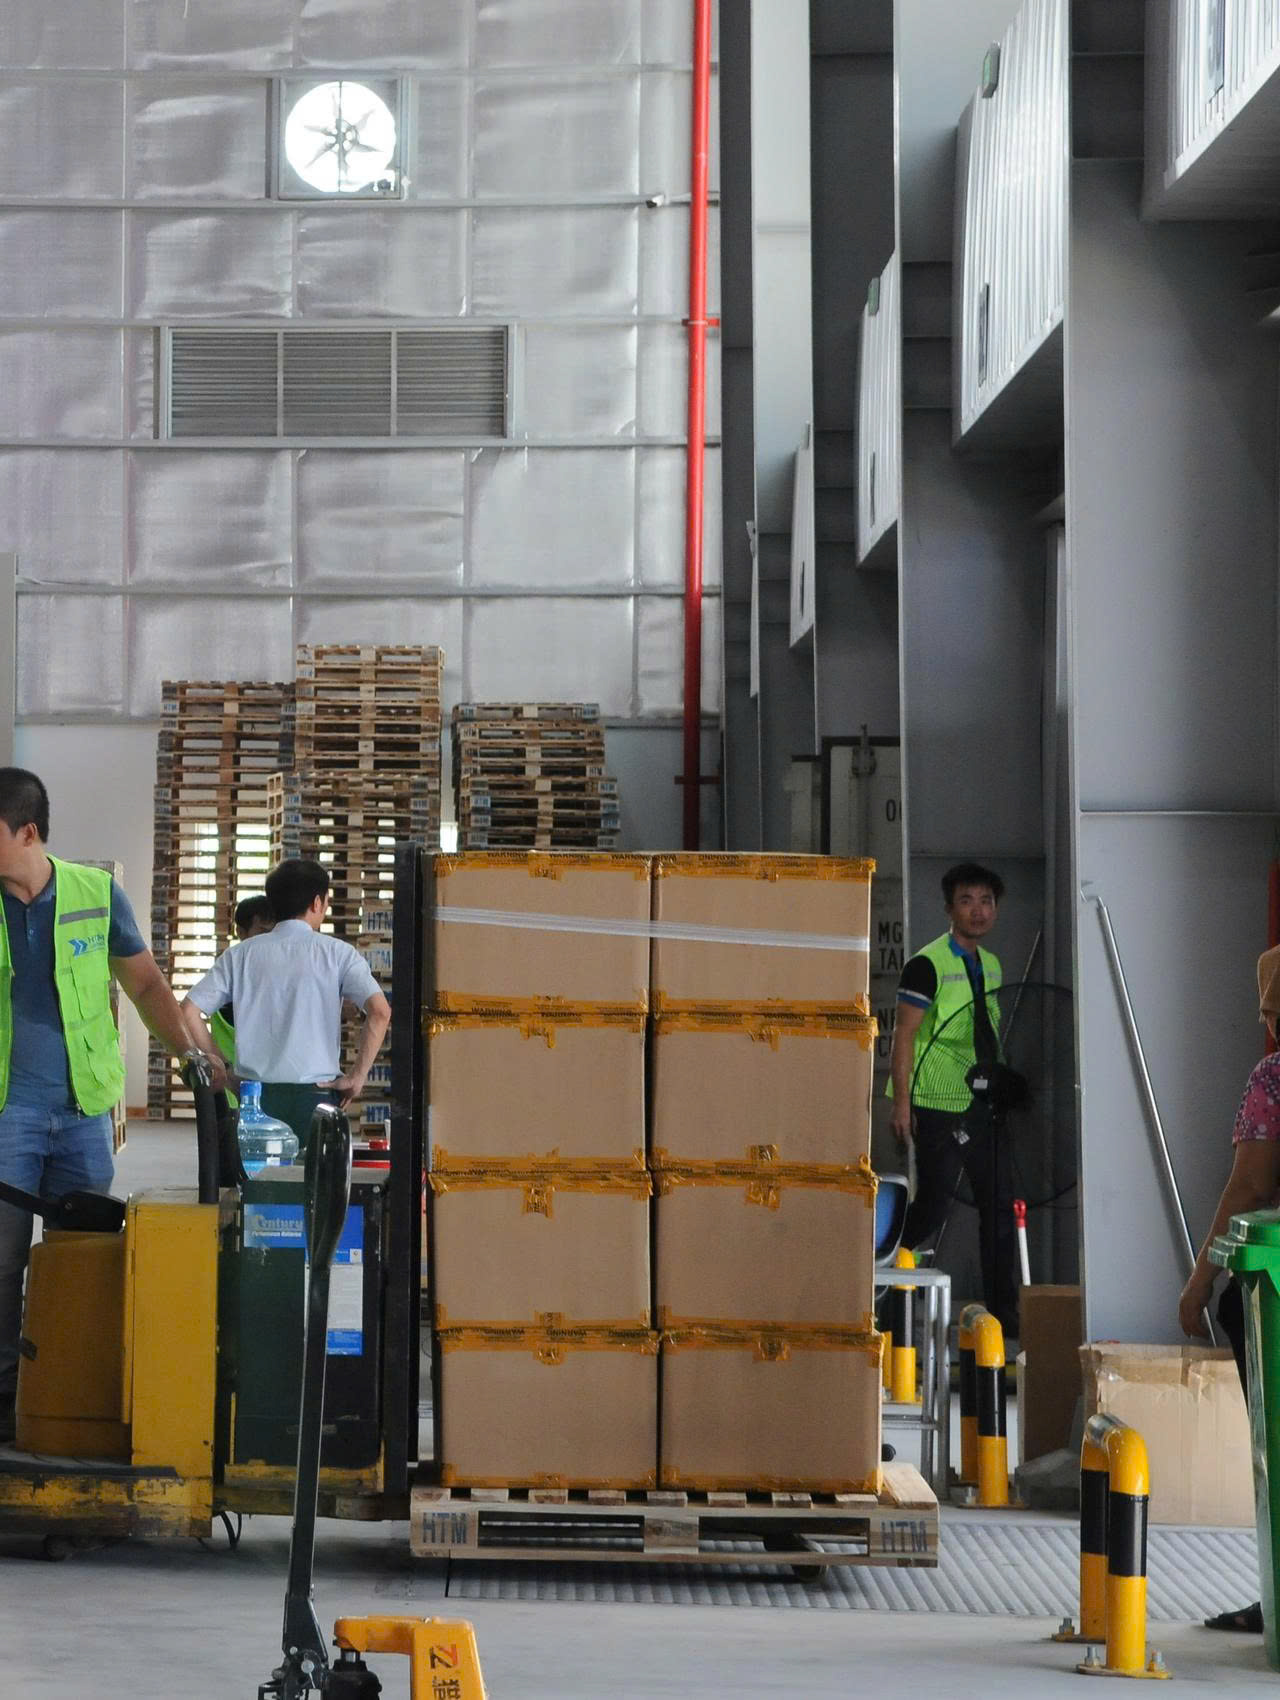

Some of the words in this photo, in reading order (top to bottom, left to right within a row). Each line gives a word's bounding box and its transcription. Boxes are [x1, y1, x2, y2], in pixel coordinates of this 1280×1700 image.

[368, 911, 393, 931] HTM
[879, 949, 905, 970] TA
[422, 1511, 468, 1545] HTM
[881, 1520, 928, 1553] HTM
